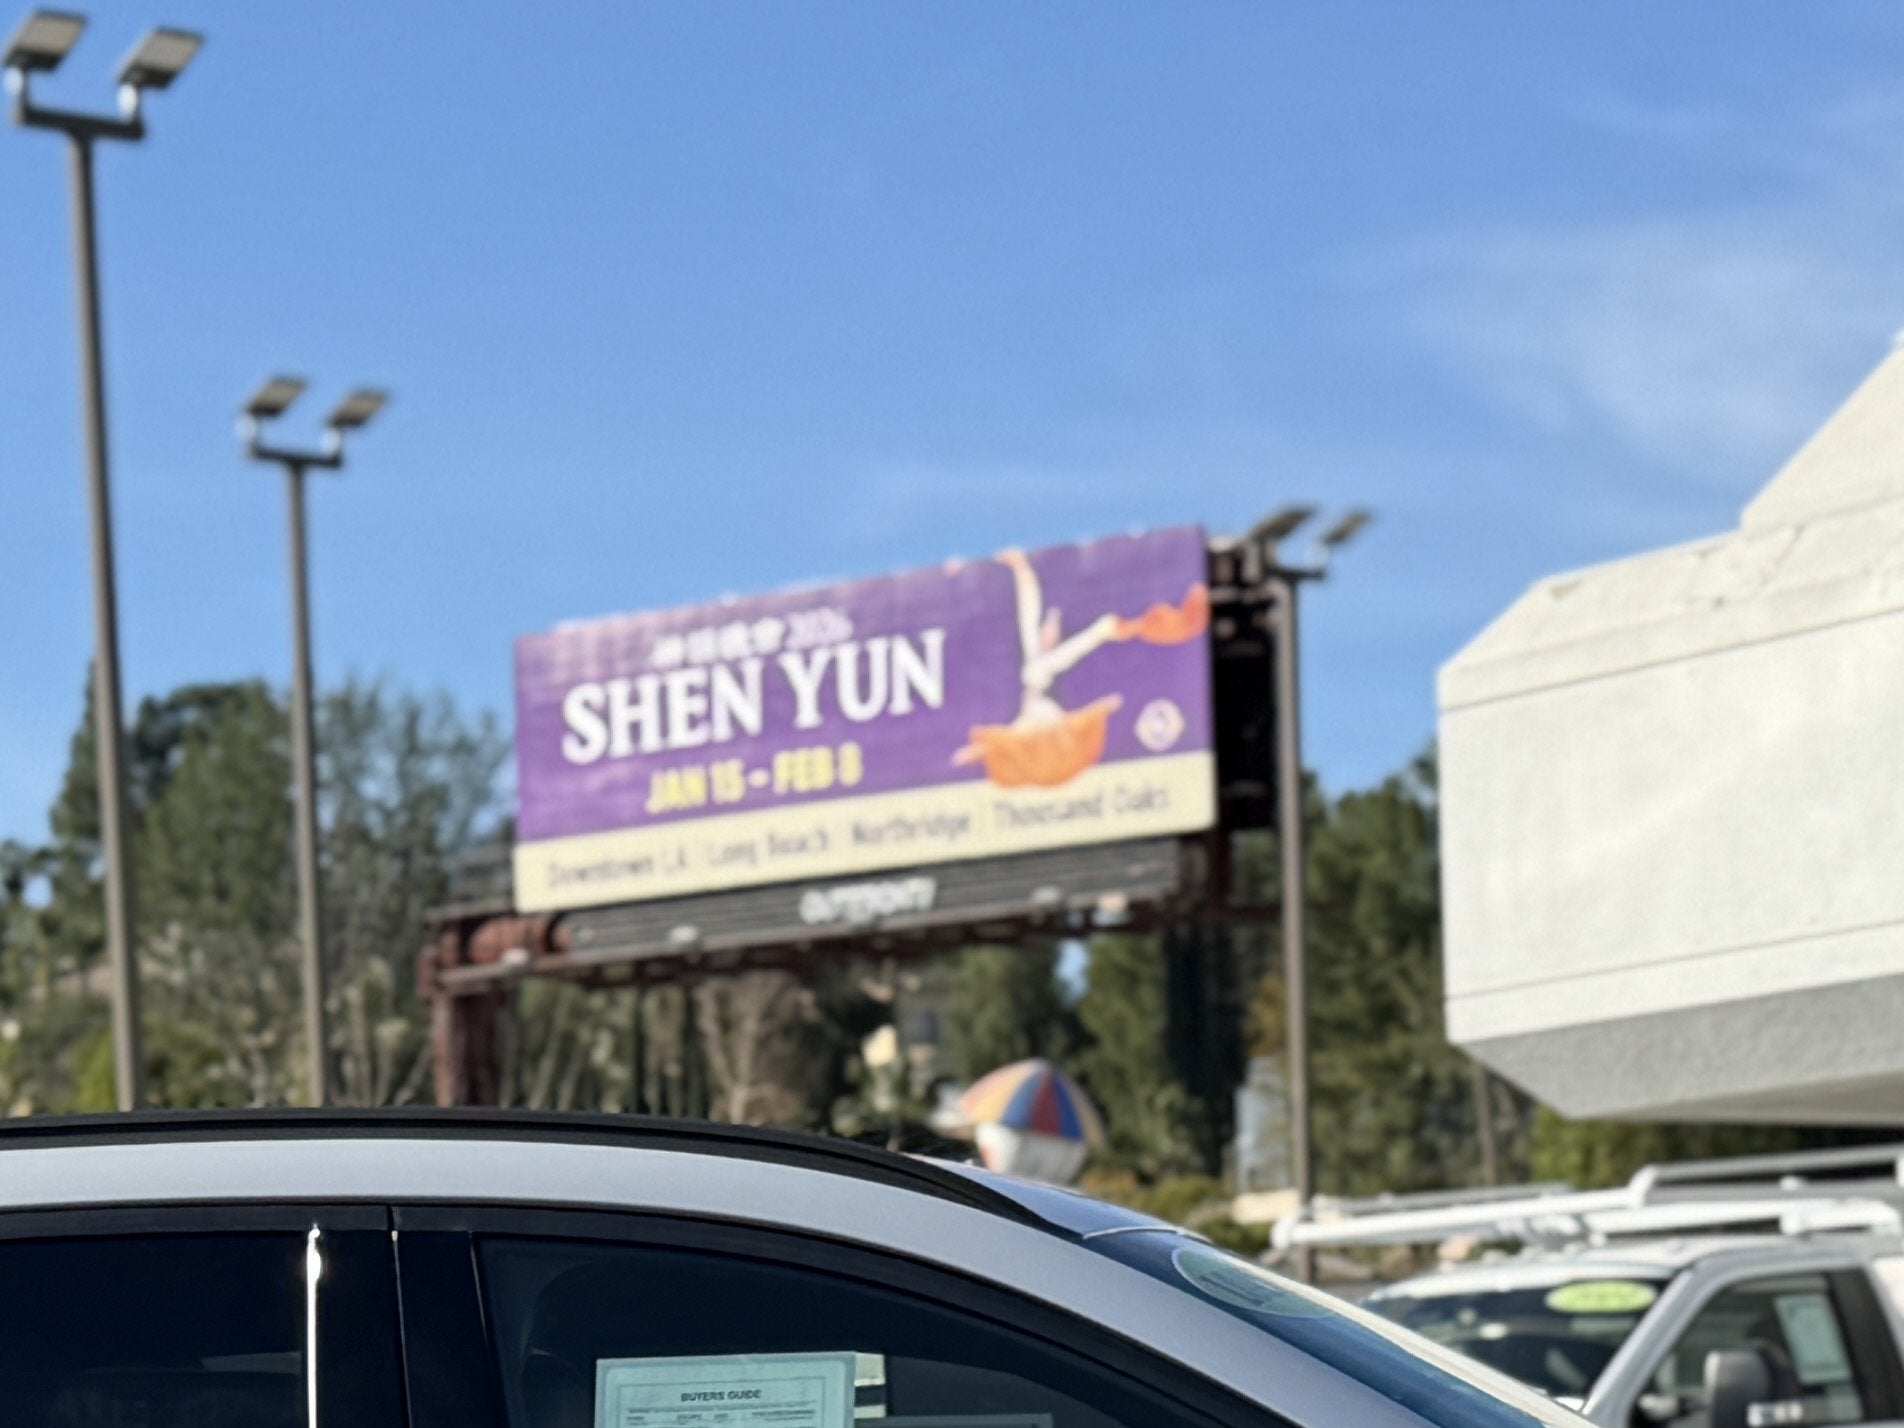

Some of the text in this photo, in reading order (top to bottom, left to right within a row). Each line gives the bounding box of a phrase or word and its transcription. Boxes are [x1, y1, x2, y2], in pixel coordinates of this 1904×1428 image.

[561, 656, 765, 766] SHEN
[776, 628, 946, 730] YUN
[645, 766, 708, 814] JAN
[773, 745, 836, 796] FEB
[681, 1389, 762, 1402] BUYERS GUIDE
